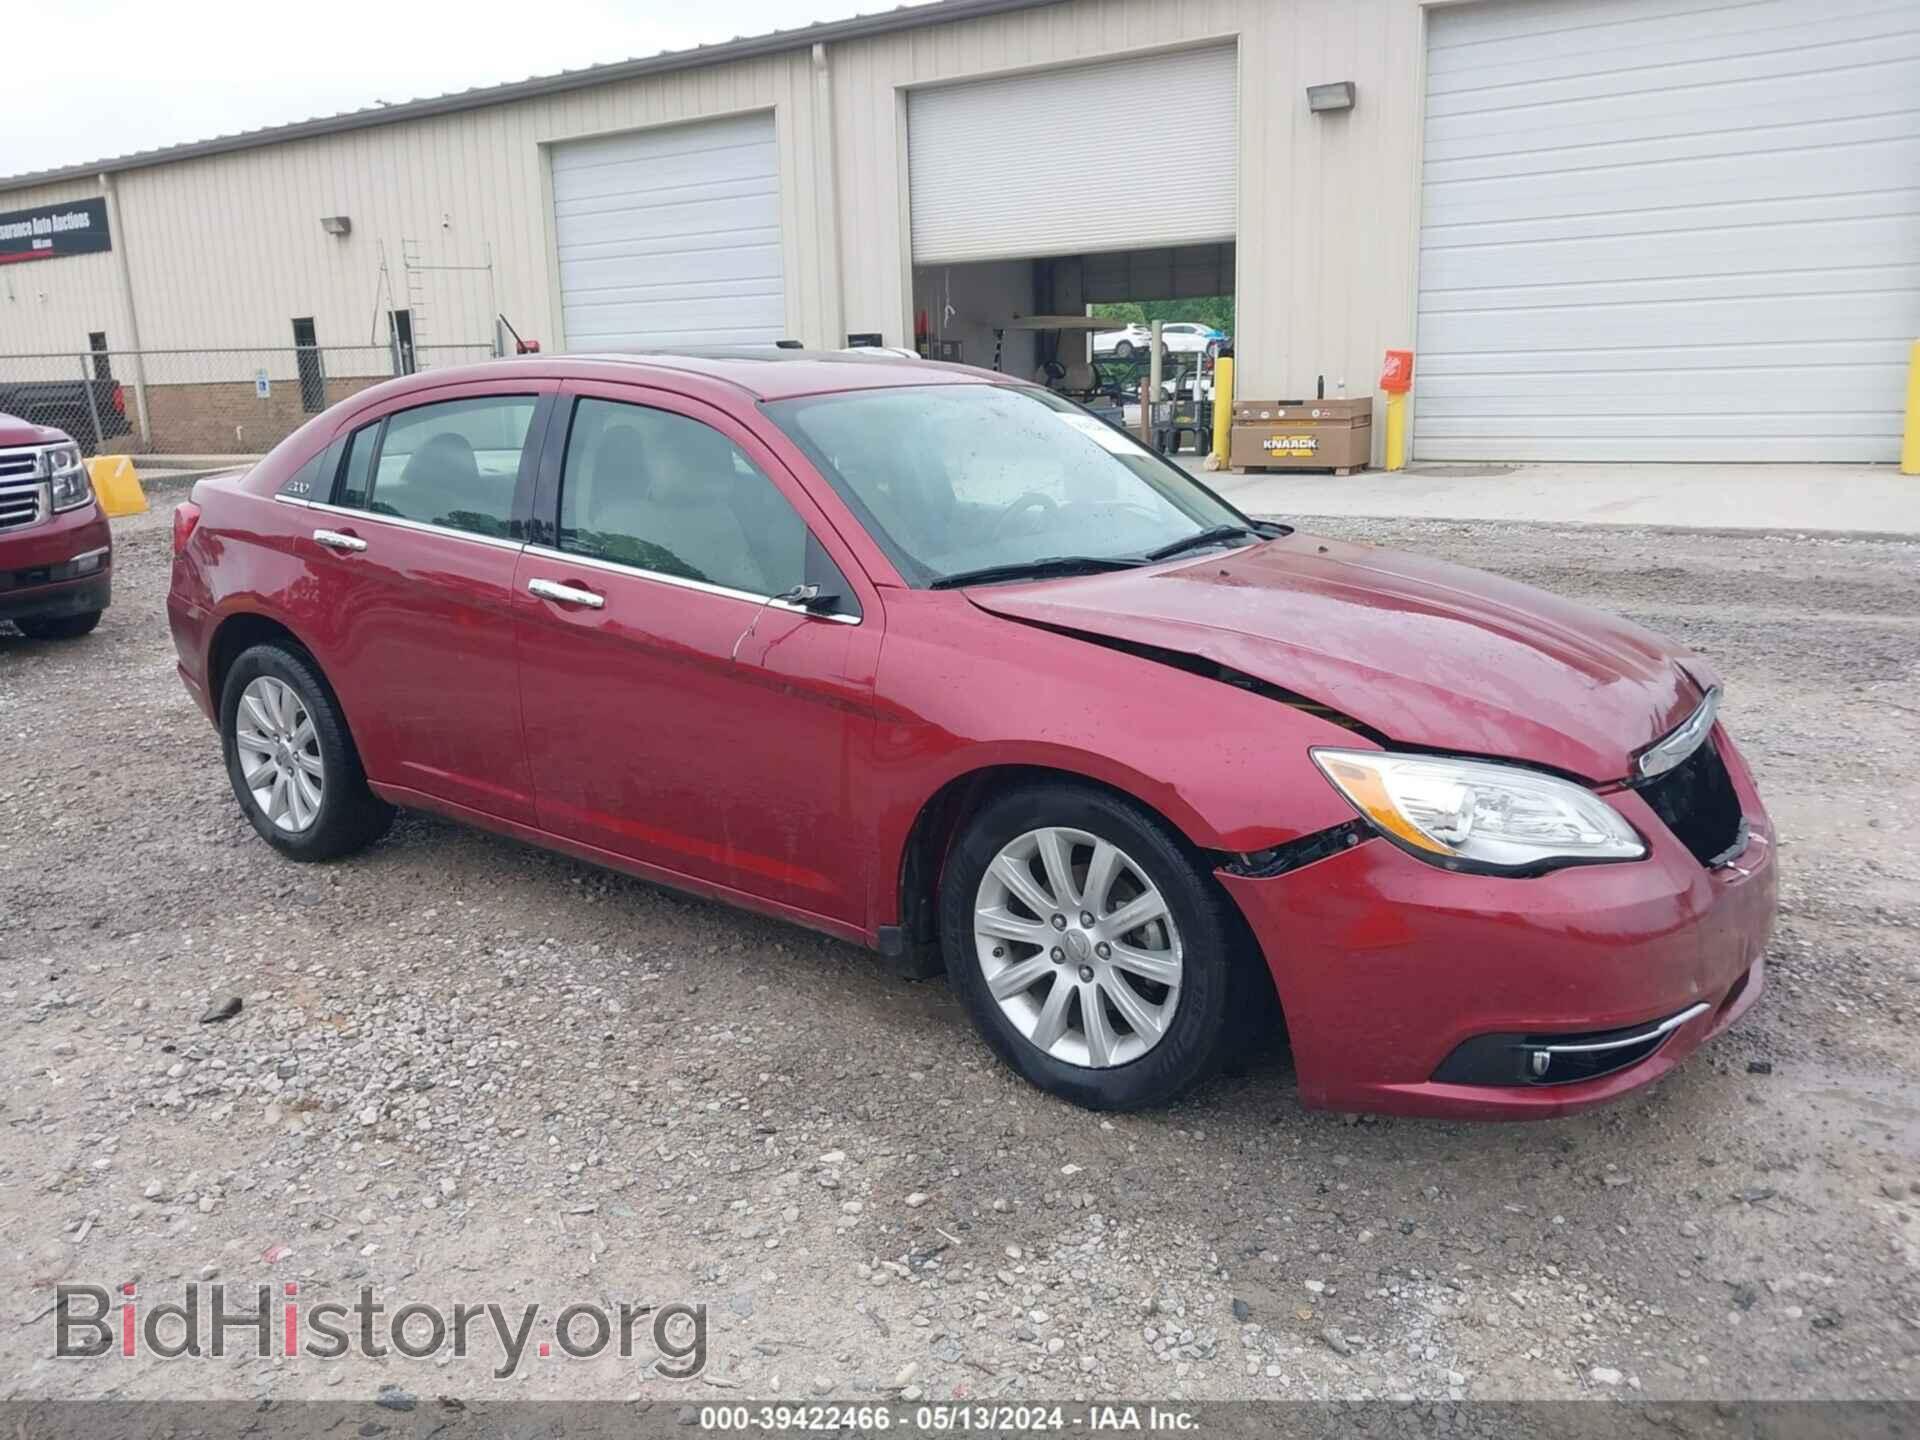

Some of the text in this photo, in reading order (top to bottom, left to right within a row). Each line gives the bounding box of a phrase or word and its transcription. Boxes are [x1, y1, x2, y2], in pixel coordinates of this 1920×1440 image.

[33, 218, 51, 235] Auto
[52, 212, 90, 232] Auctions
[1263, 439, 1318, 449] KNAACK
